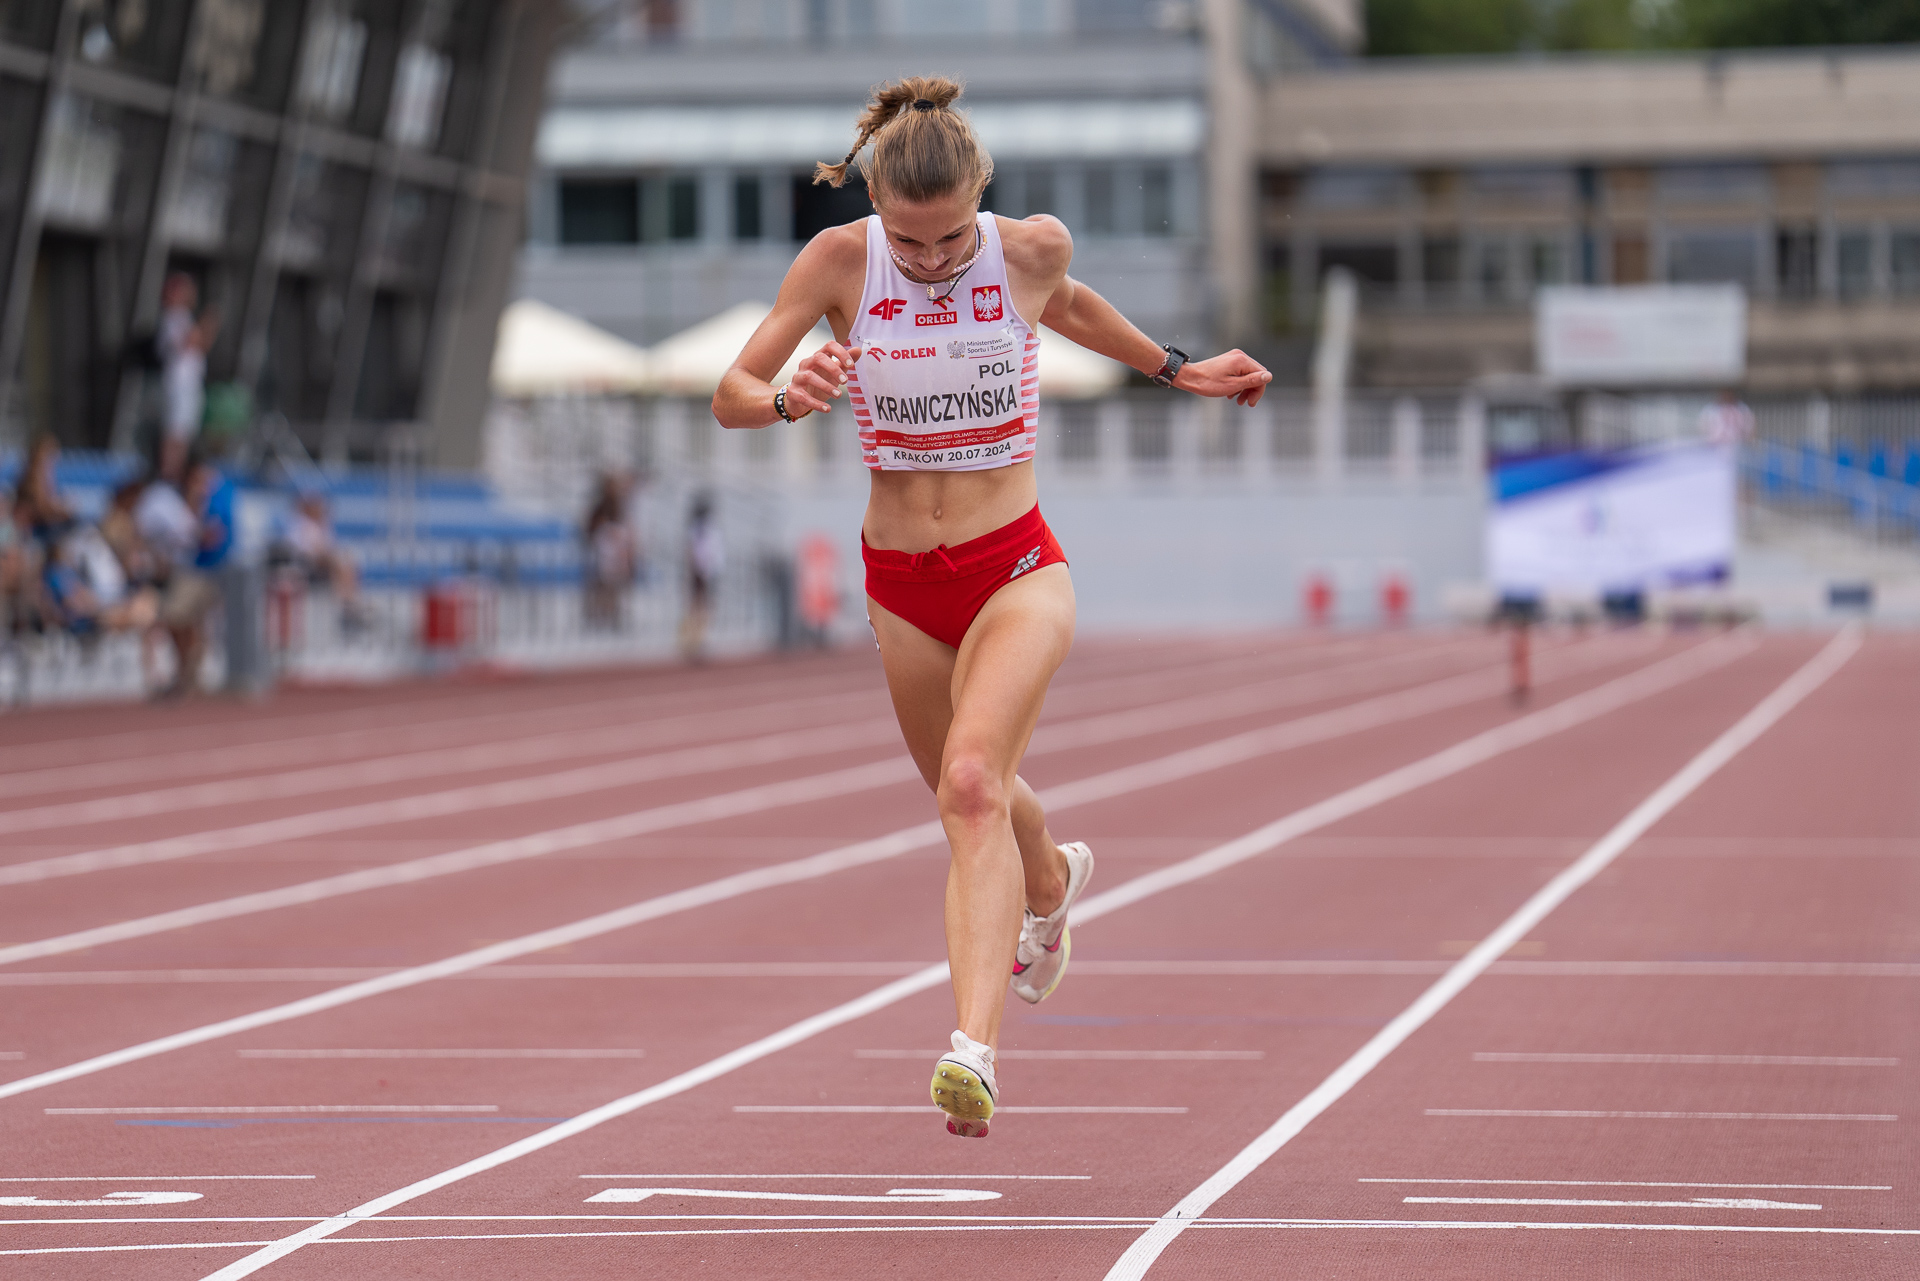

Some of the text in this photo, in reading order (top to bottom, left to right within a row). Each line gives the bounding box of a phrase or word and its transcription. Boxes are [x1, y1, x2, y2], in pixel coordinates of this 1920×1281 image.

[868, 297, 908, 321] 4F
[917, 313, 955, 325] ORLEN
[966, 338, 1003, 346] Ministerstwo
[990, 340, 1013, 351] Turystyki
[891, 346, 937, 360] ORLEN
[978, 360, 1016, 379] POL
[874, 384, 1017, 424] KRAWCZYŃSKA
[893, 441, 1012, 464] KRAKÓW 20.07.2024
[582, 1187, 1004, 1203] 2
[1401, 1196, 1825, 1211] 1
